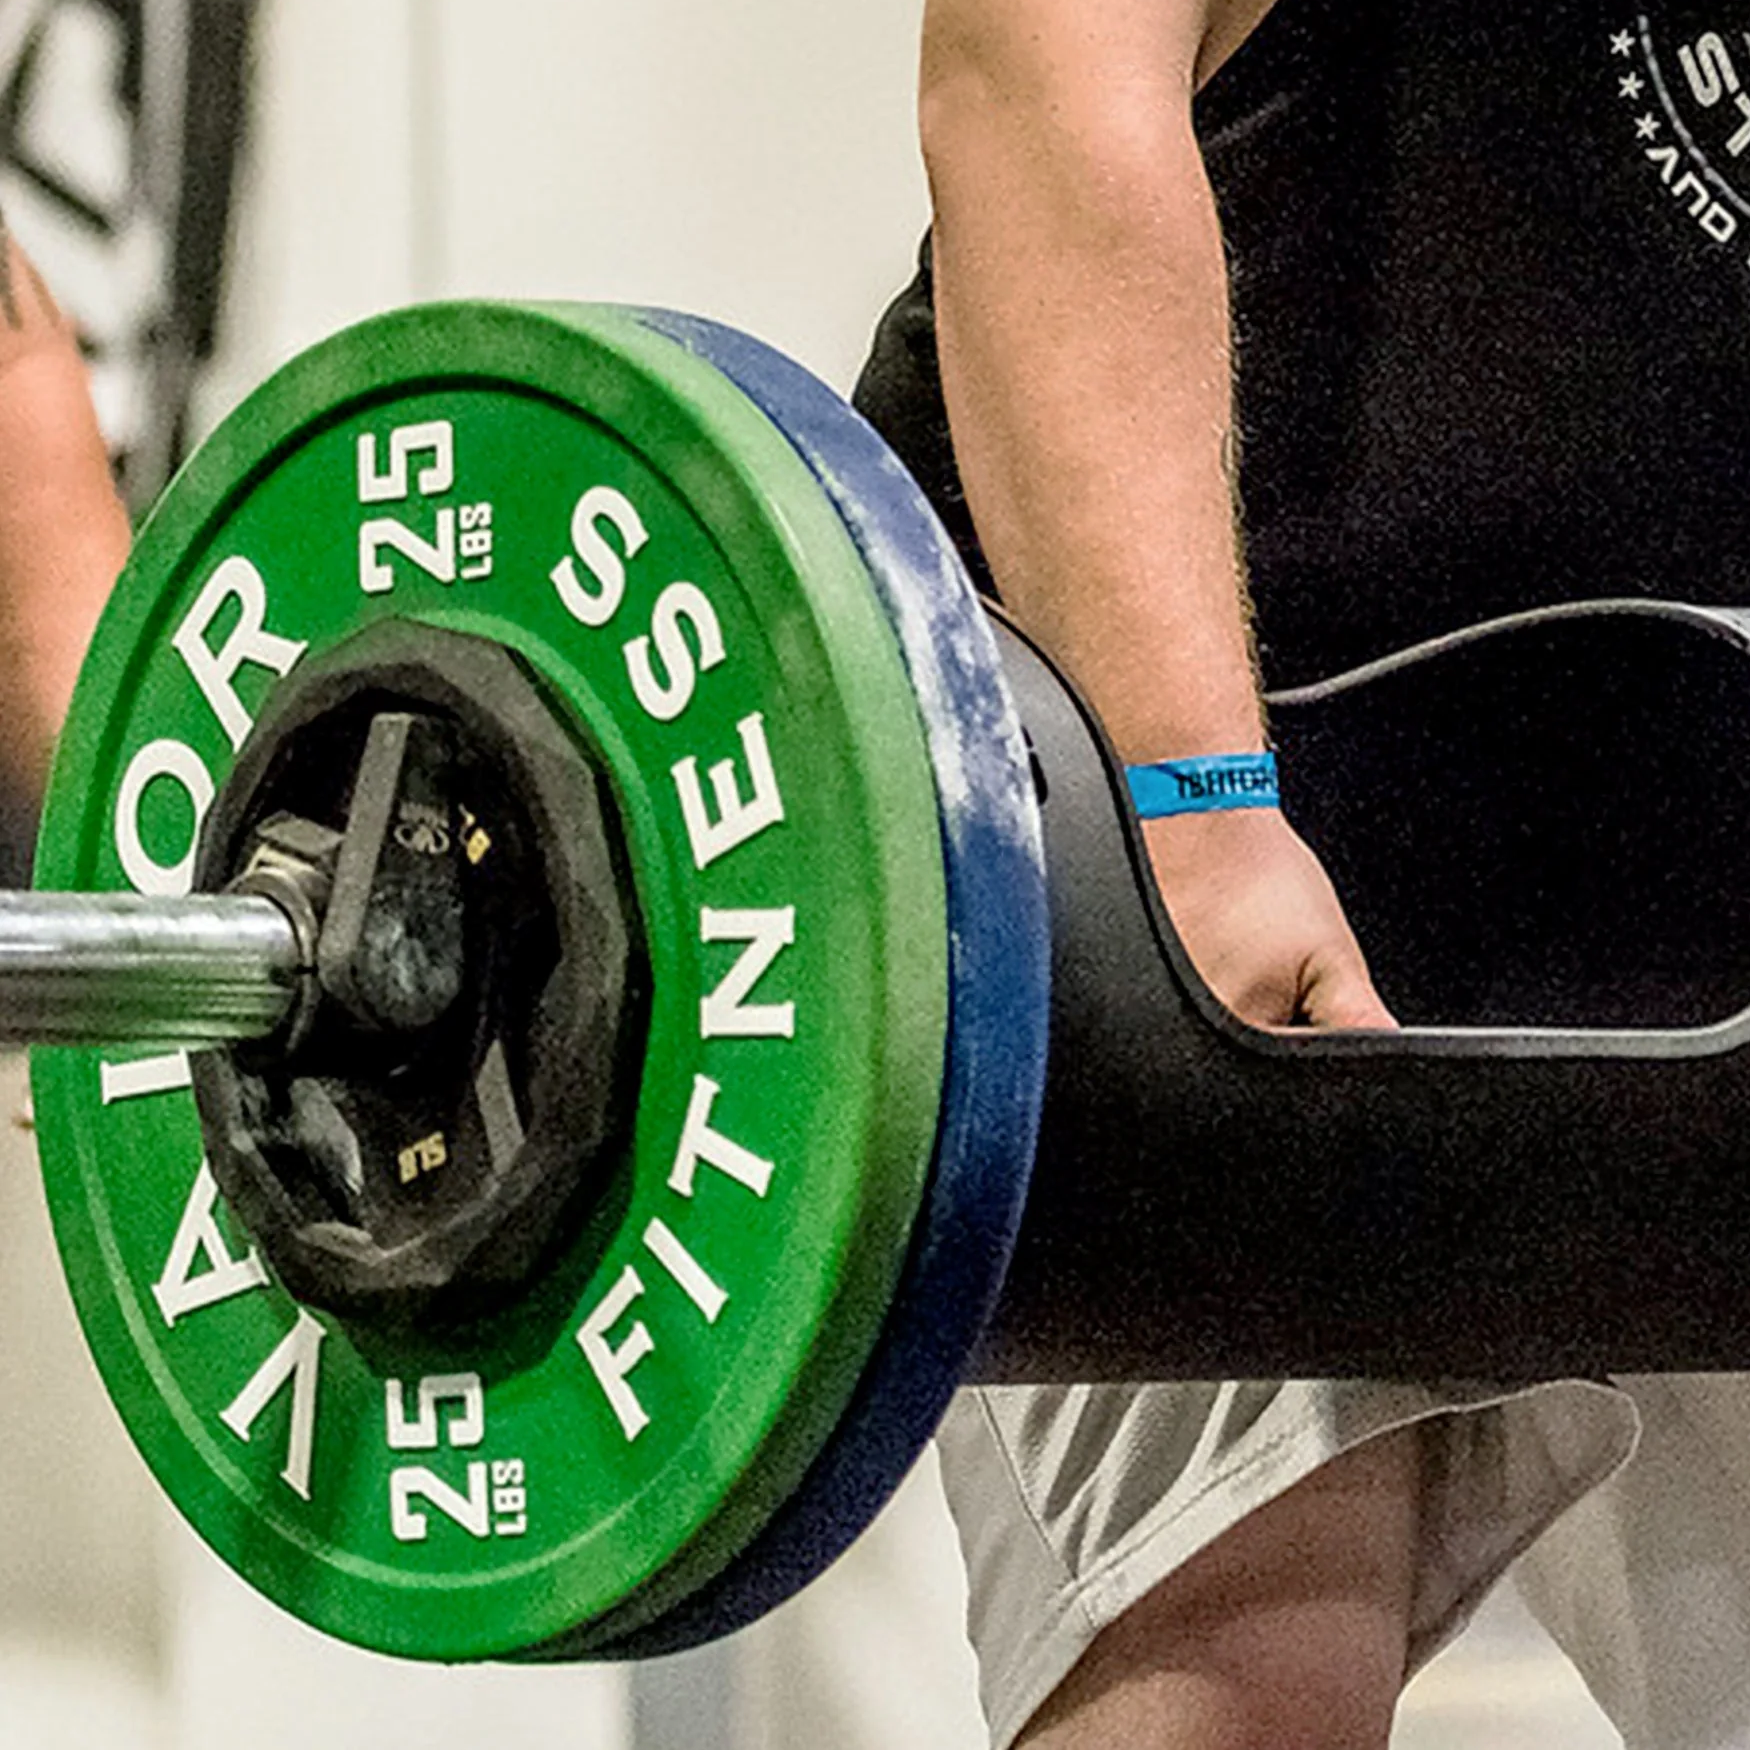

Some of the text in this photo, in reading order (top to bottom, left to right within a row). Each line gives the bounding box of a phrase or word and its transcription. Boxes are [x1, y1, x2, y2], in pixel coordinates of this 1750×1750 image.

[1645, 144, 1738, 245] AND
[358, 419, 456, 594] 25
[457, 502, 493, 581] LBS
[549, 485, 796, 1442] FITNESS
[389, 1371, 488, 1542] 25
[494, 1458, 528, 1536] LBS
